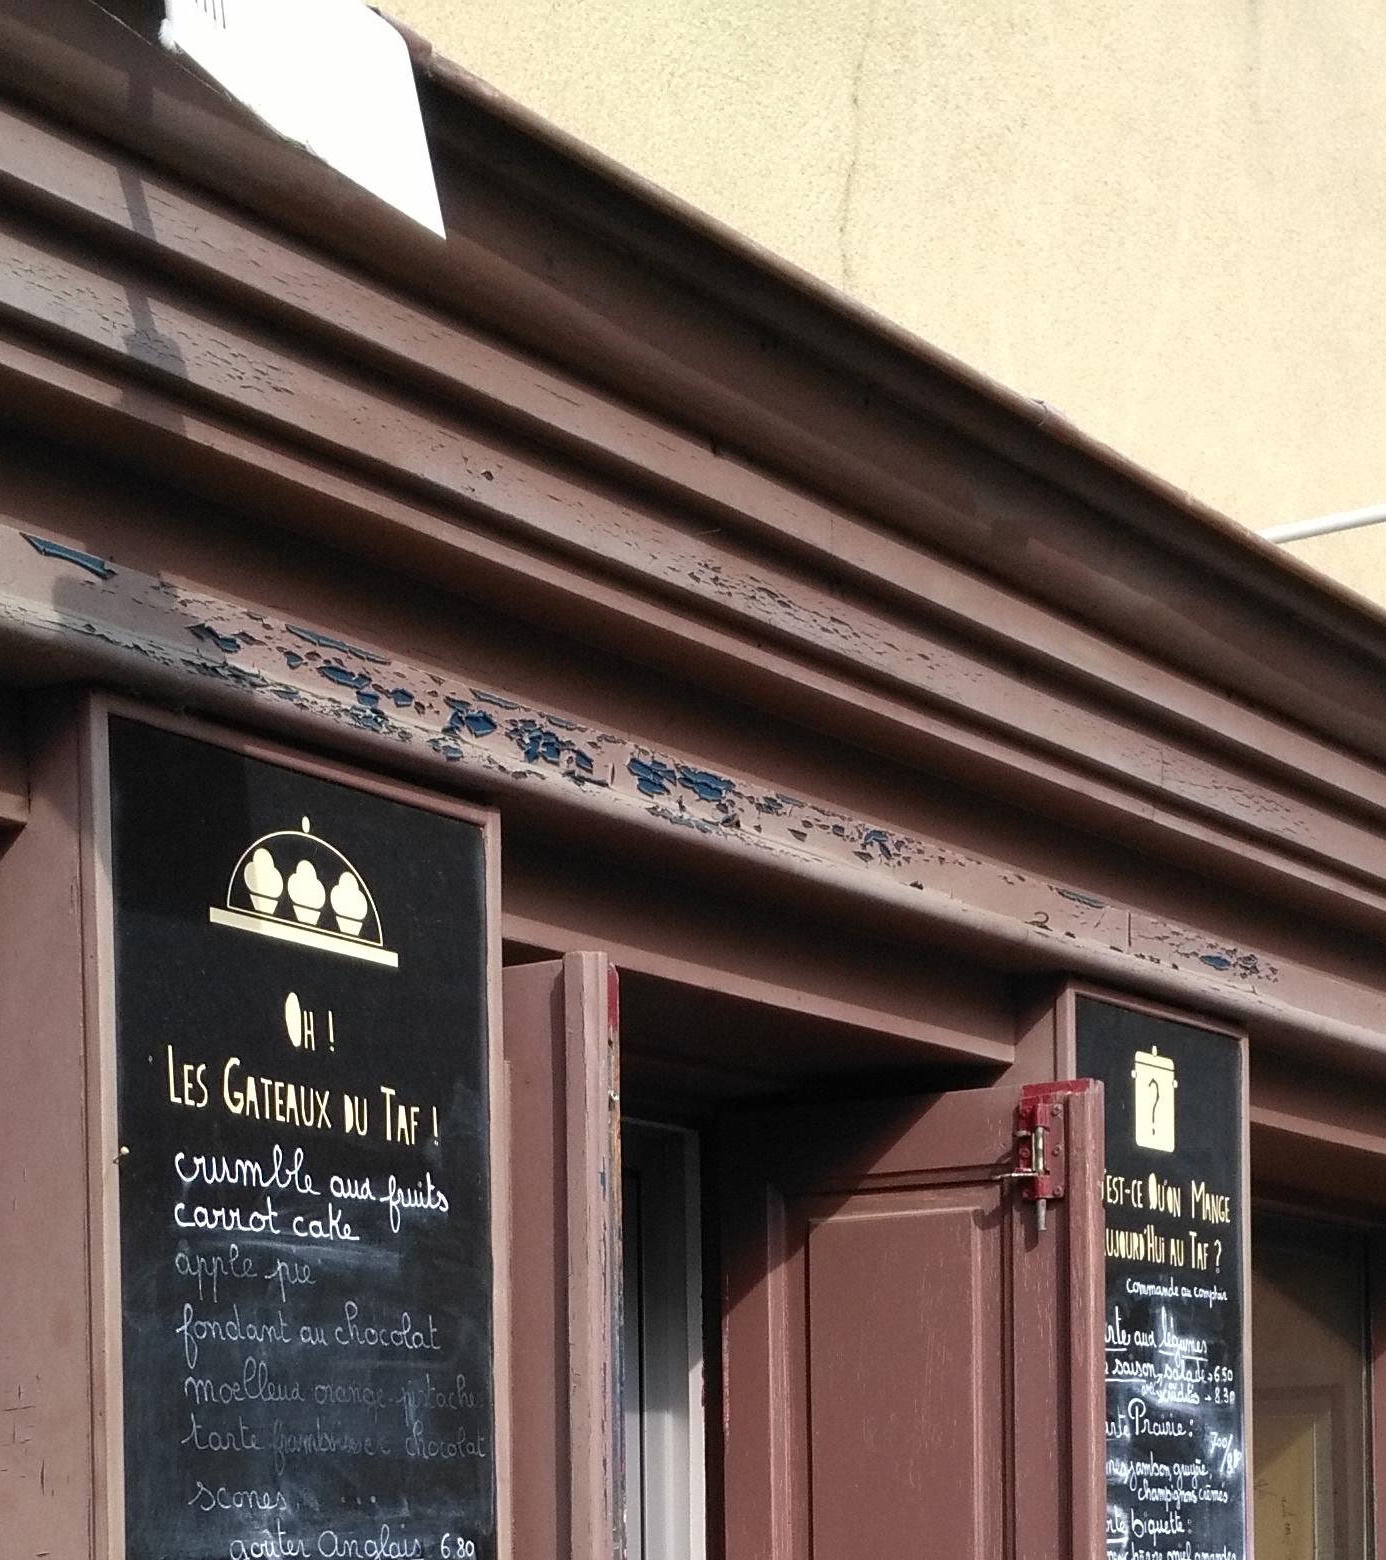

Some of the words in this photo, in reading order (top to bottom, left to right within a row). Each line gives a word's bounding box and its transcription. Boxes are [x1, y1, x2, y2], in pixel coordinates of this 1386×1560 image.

[174, 1144, 319, 1196] crumble
[329, 1174, 376, 1200] aux
[380, 1172, 450, 1233] fruits
[174, 1197, 282, 1234] carrot
[293, 1203, 360, 1241] cake
[175, 1243, 258, 1302] apple
[265, 1257, 317, 1302] pie
[175, 1303, 293, 1370] fondant
[300, 1325, 329, 1347] au
[334, 1300, 442, 1351] chocolat
[184, 1355, 306, 1405] moelleux
[180, 1411, 263, 1451] tarte
[405, 1419, 486, 1459] chocolat
[188, 1481, 288, 1512] scones
